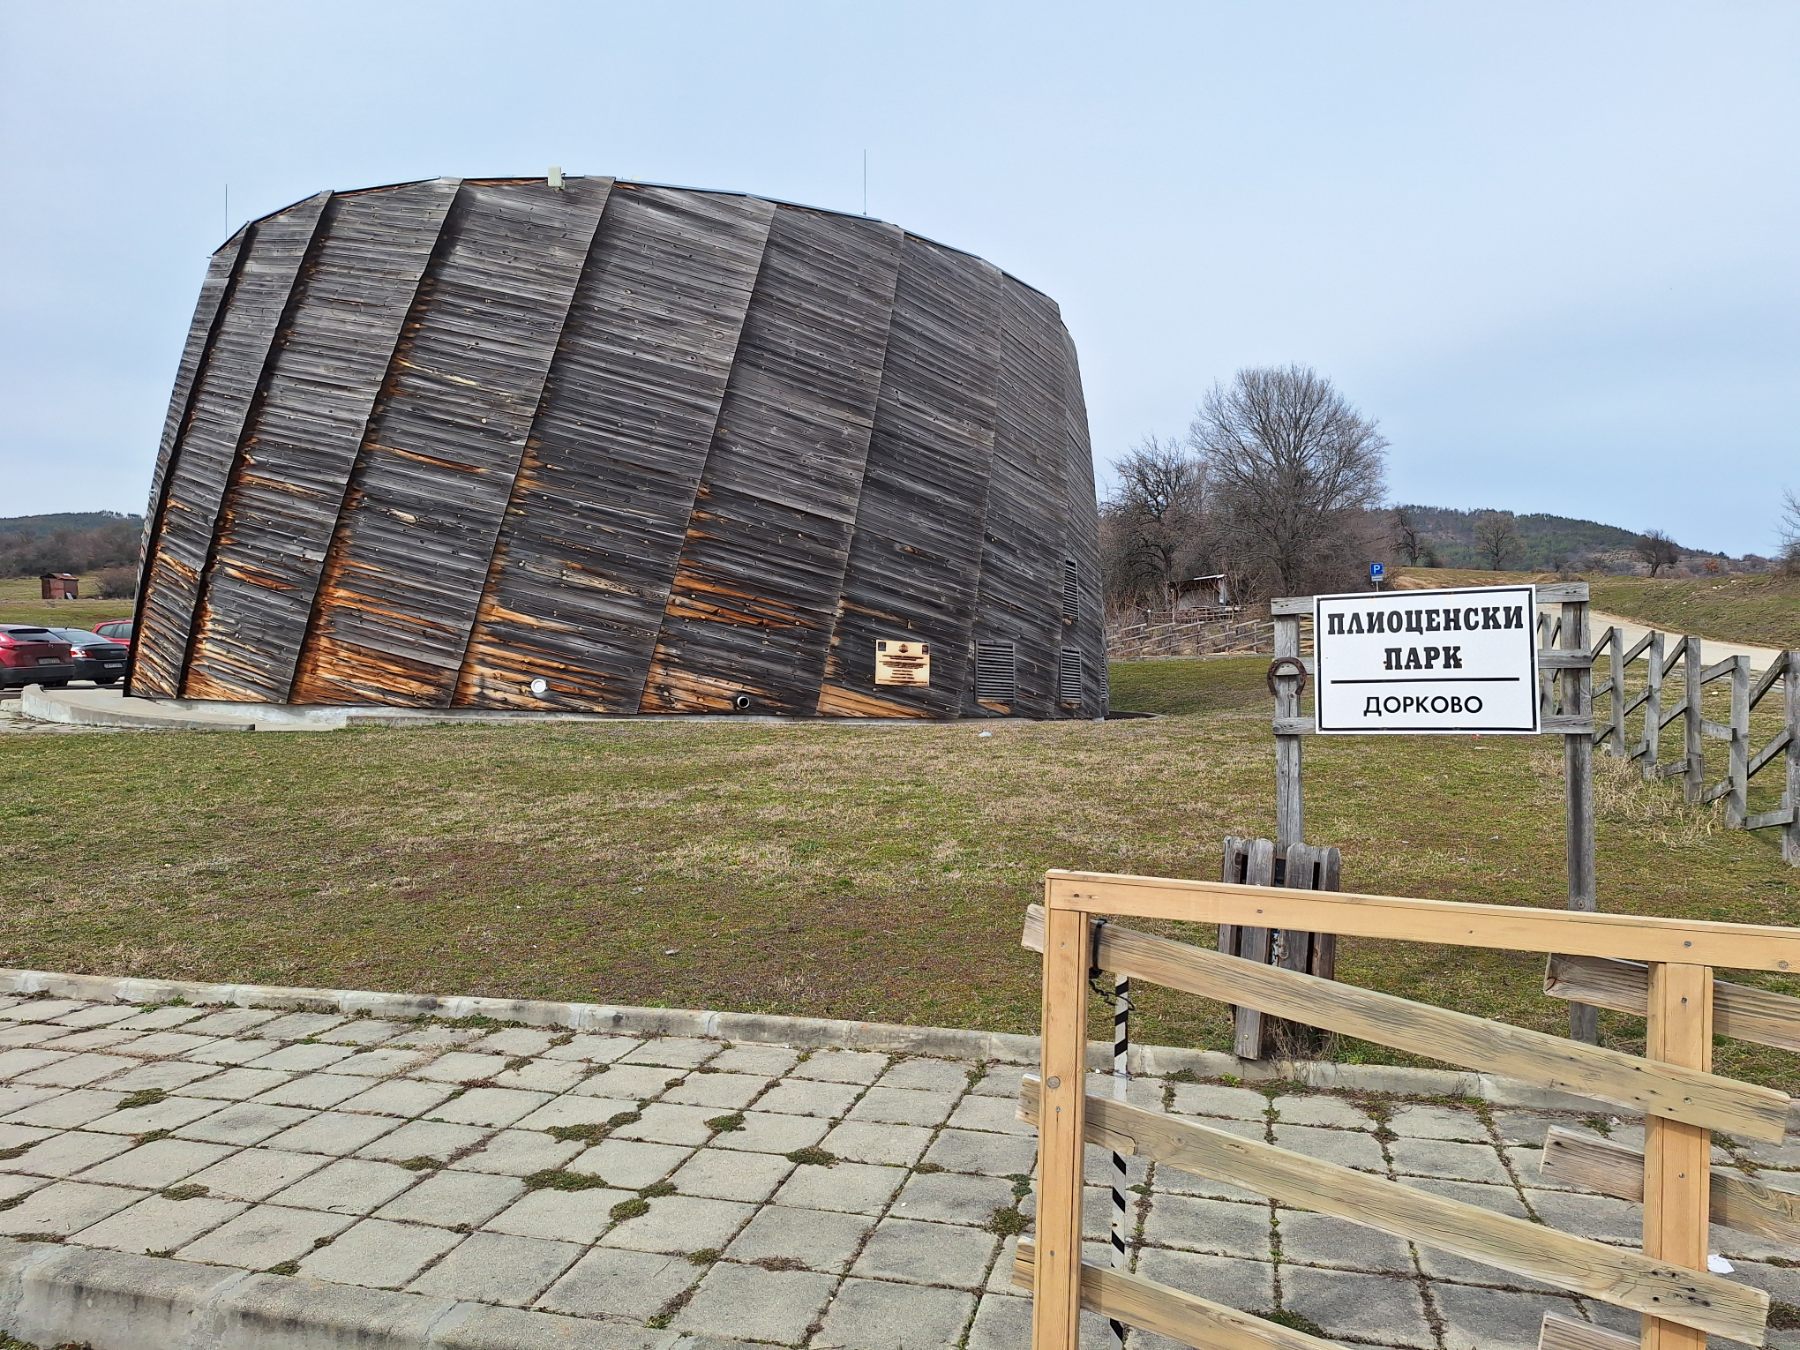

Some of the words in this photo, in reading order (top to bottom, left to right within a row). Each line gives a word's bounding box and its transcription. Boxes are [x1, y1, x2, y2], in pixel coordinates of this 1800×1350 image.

[1373, 564, 1381, 574] P
[1327, 605, 1524, 635] ПЛИОЦЕНСКИ
[1384, 646, 1463, 670] ПАРК
[1363, 695, 1483, 717] ДОРКОВО
